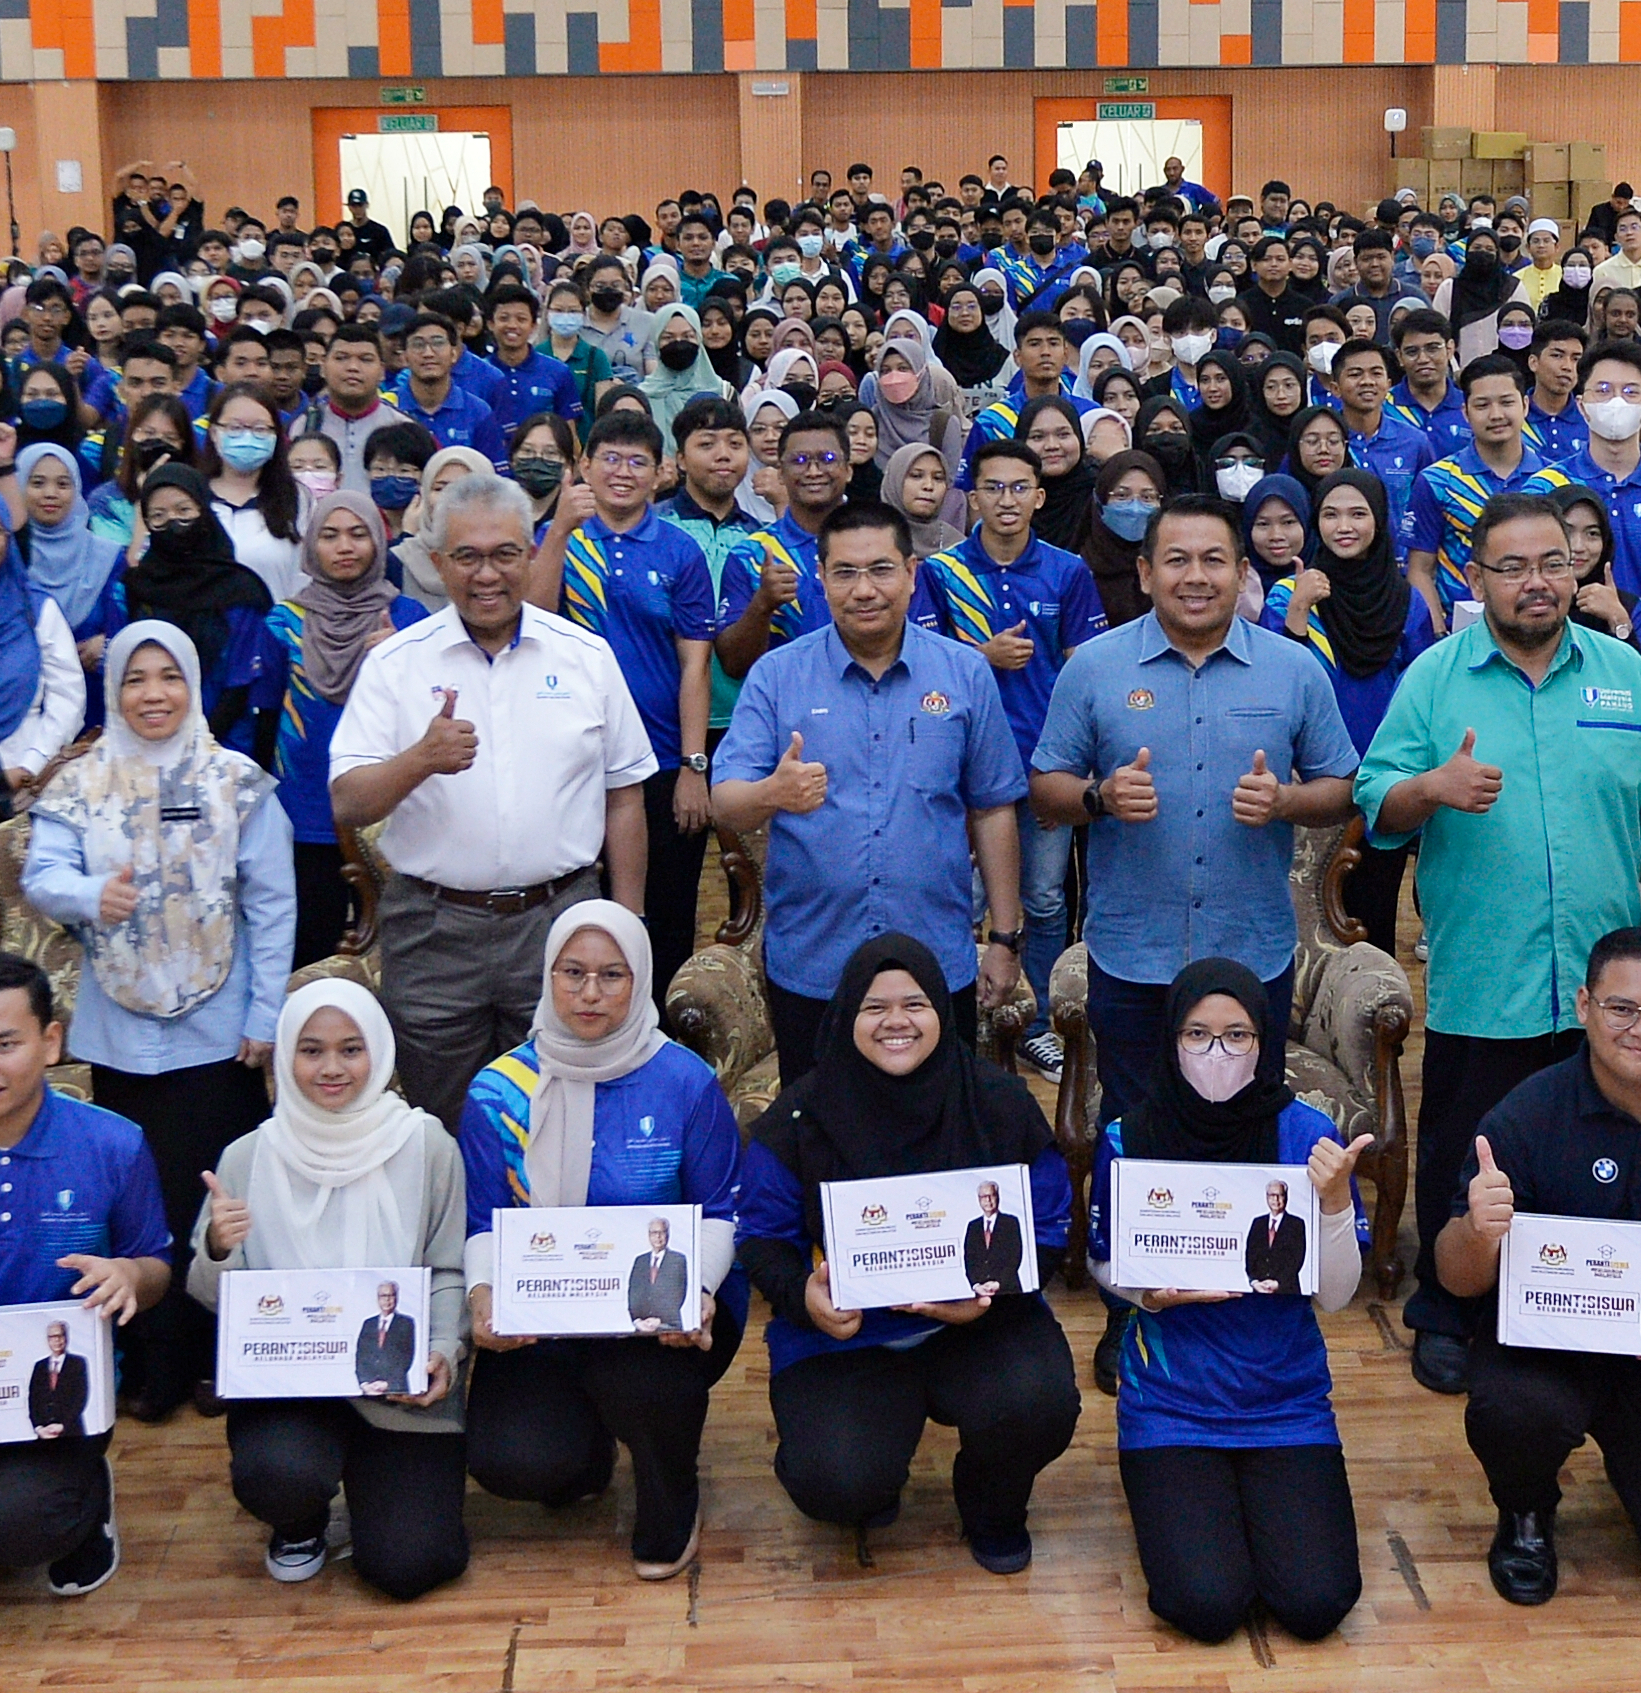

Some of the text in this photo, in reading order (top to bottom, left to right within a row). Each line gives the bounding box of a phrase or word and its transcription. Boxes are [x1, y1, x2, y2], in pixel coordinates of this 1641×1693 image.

[1101, 105, 1140, 118] KELUAR
[1134, 1234, 1238, 1250] PERANTISISWA
[853, 1245, 956, 1267] PERANTISISWA
[517, 1278, 620, 1292] PERANTISISWA
[1525, 1291, 1635, 1312] PERANTISISWA
[243, 1341, 348, 1356] PERANTISISWA
